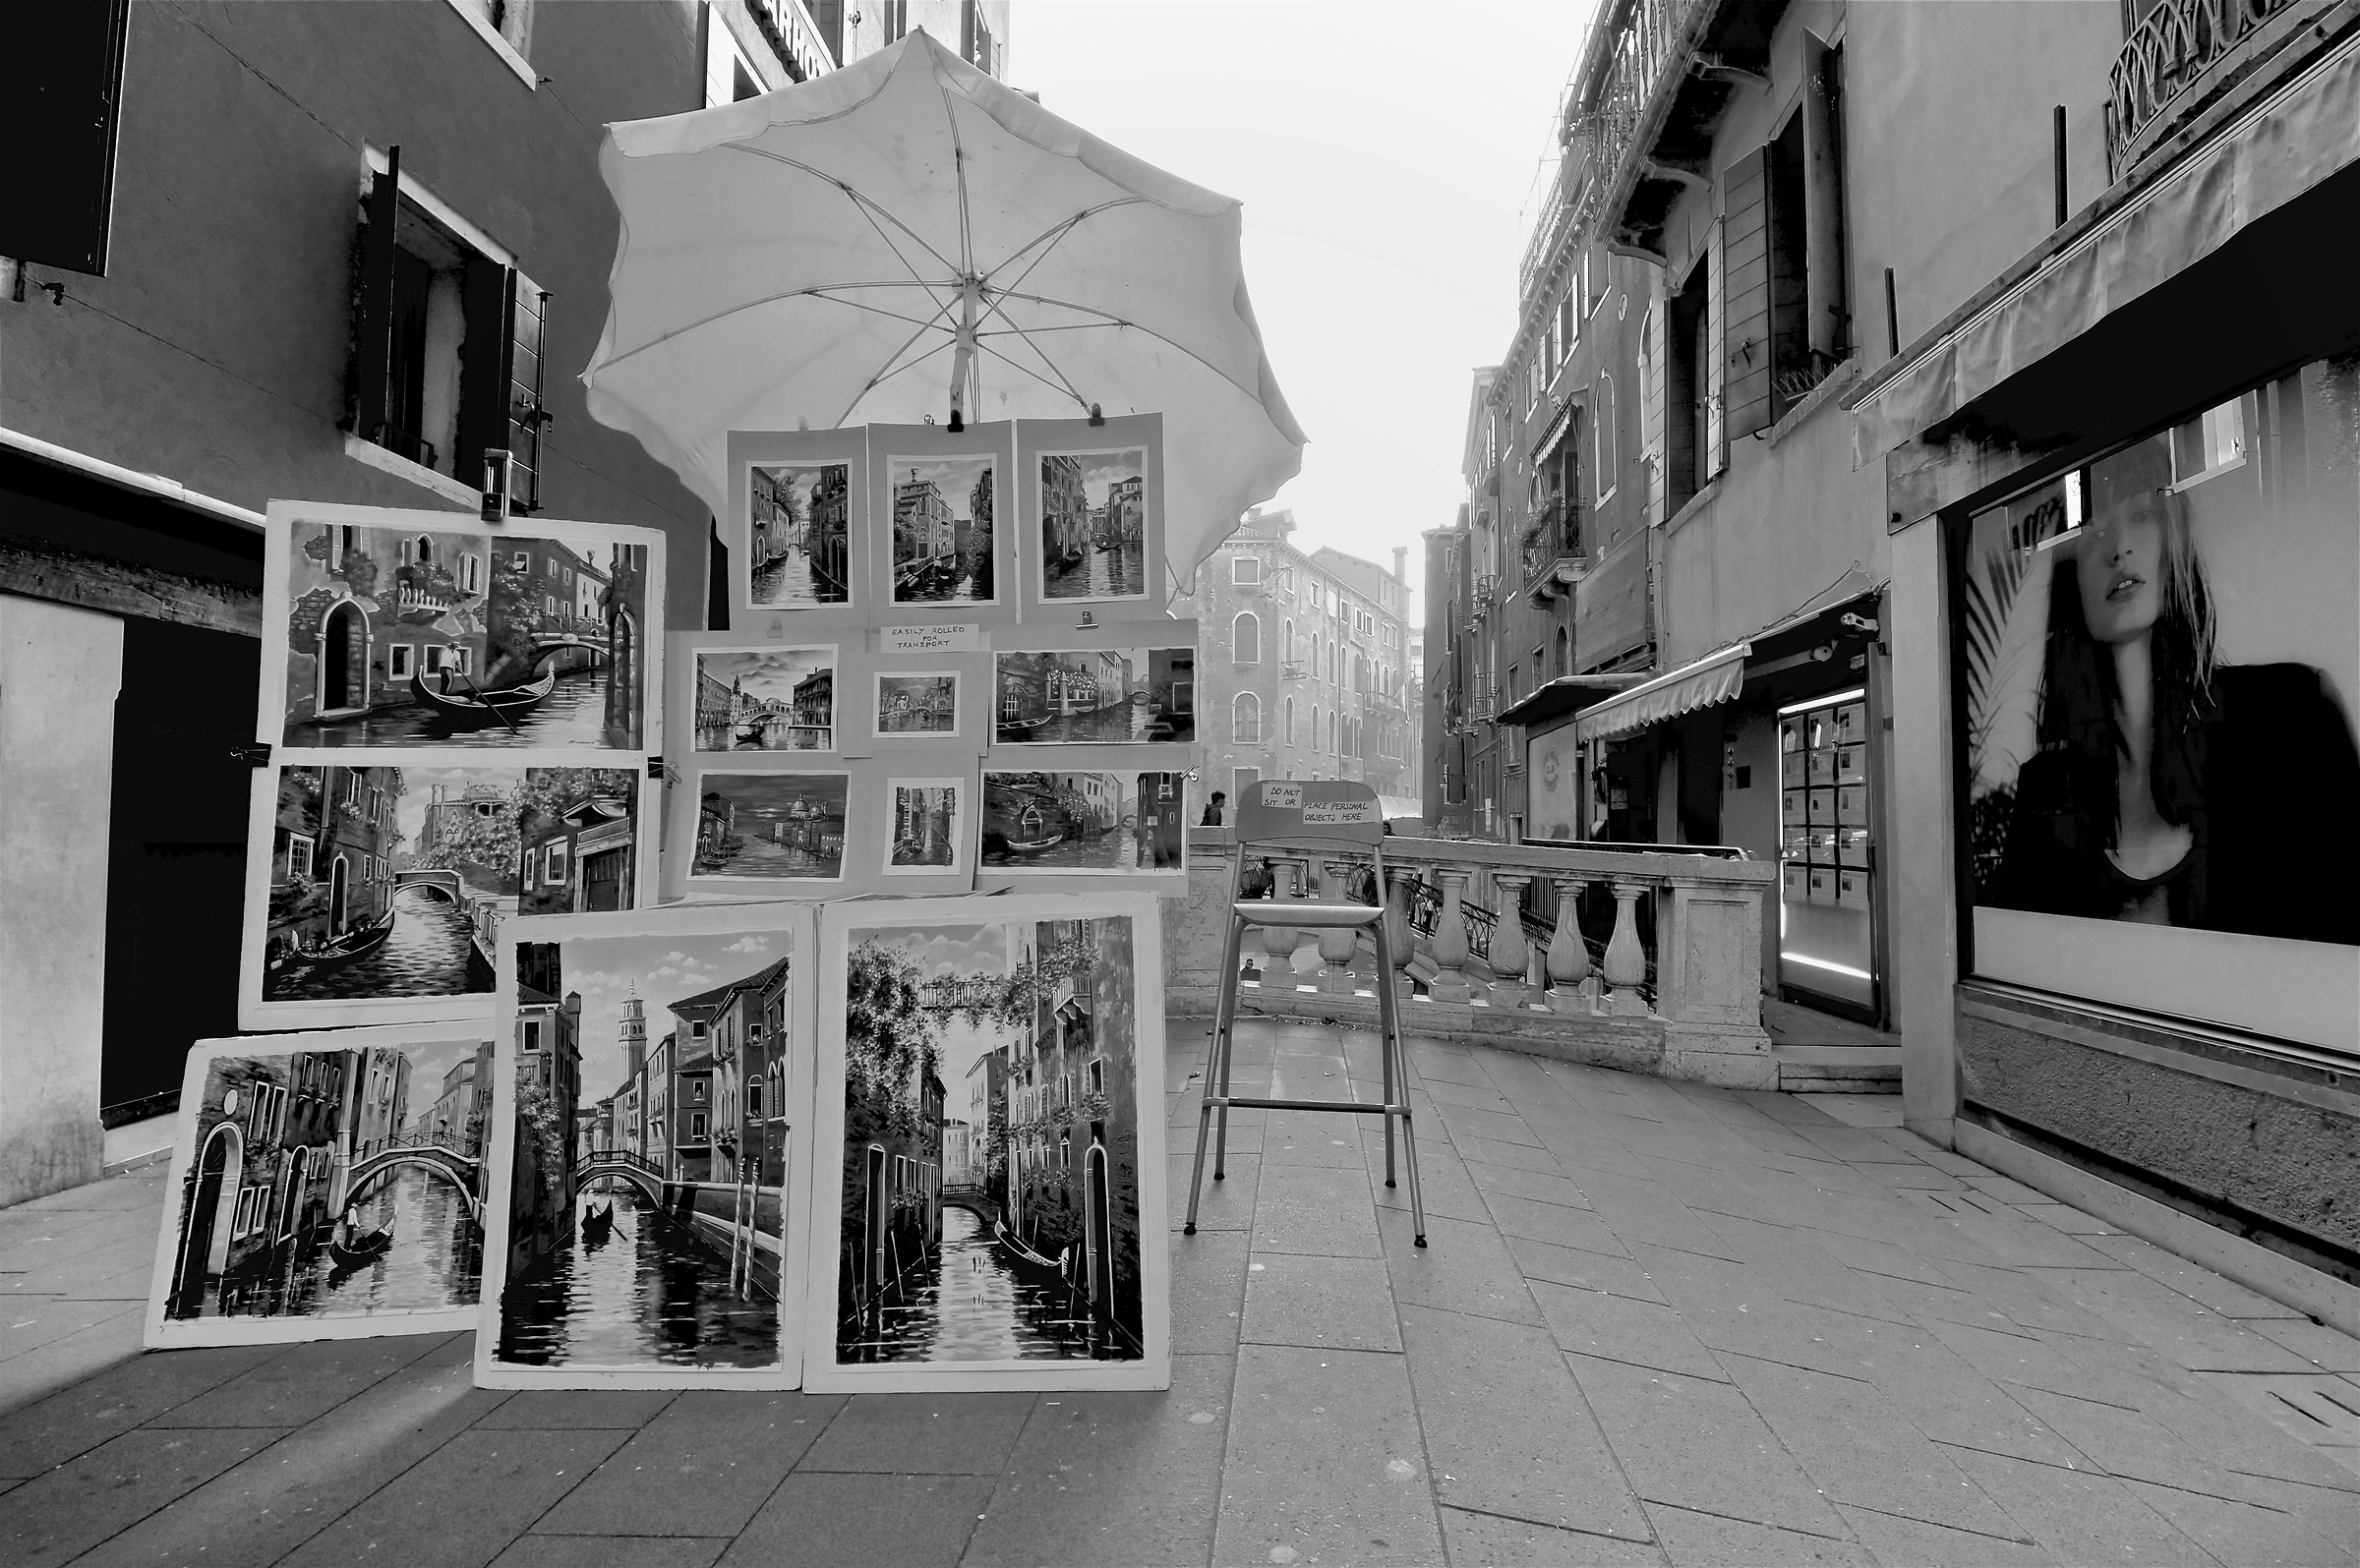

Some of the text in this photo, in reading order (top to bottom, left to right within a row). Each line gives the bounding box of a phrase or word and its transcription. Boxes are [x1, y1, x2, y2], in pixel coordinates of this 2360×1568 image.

[1303, 801, 1369, 811] PLACE PERSONAL
[1304, 813, 1336, 822] OBJECTS
